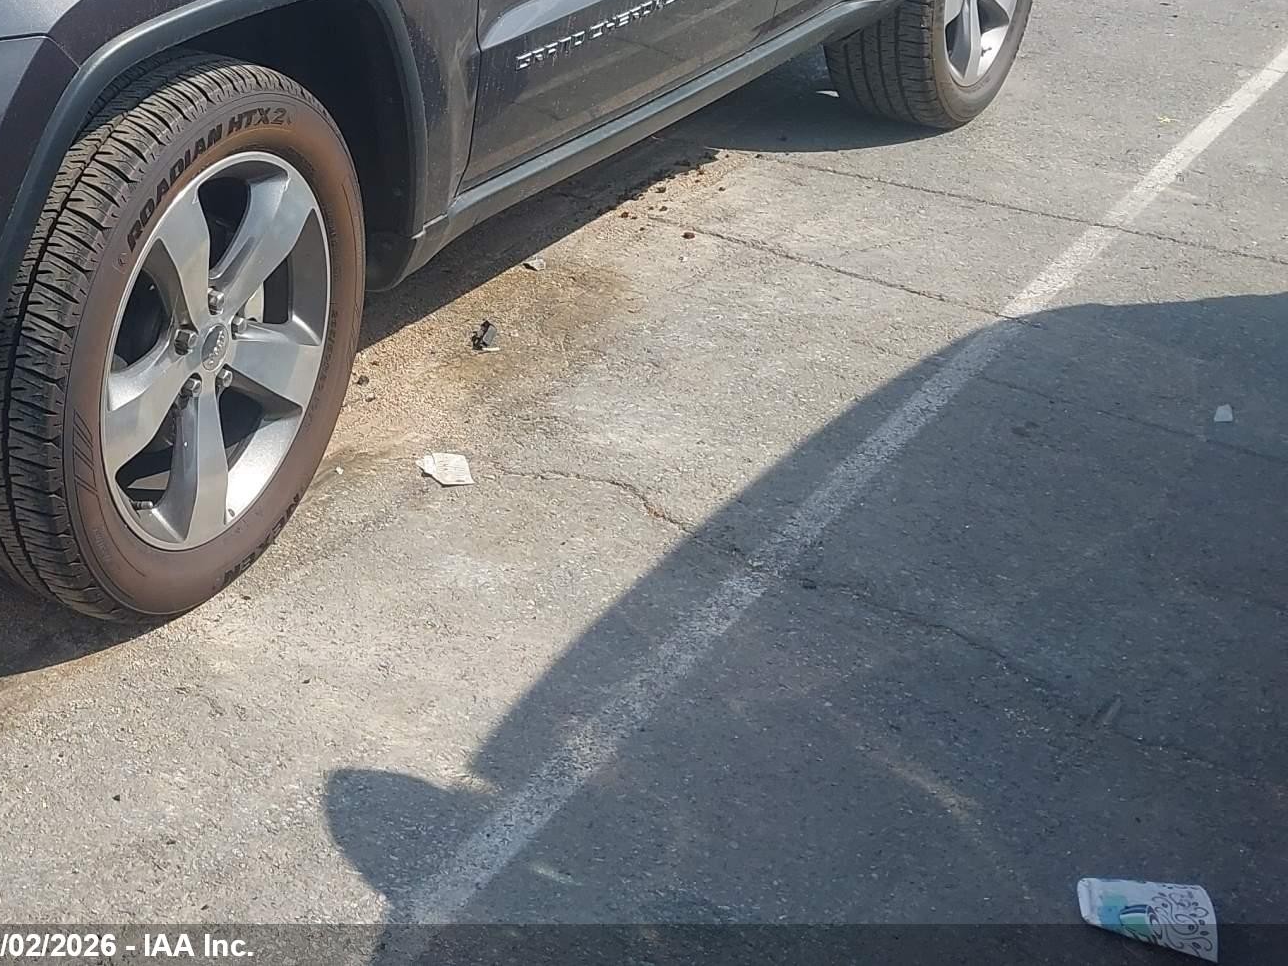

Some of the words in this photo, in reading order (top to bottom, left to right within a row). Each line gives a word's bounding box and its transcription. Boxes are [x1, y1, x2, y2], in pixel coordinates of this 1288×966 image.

[515, 30, 587, 71] GRAND
[126, 124, 224, 253] ROADIAN
[228, 107, 289, 135] HTX2
